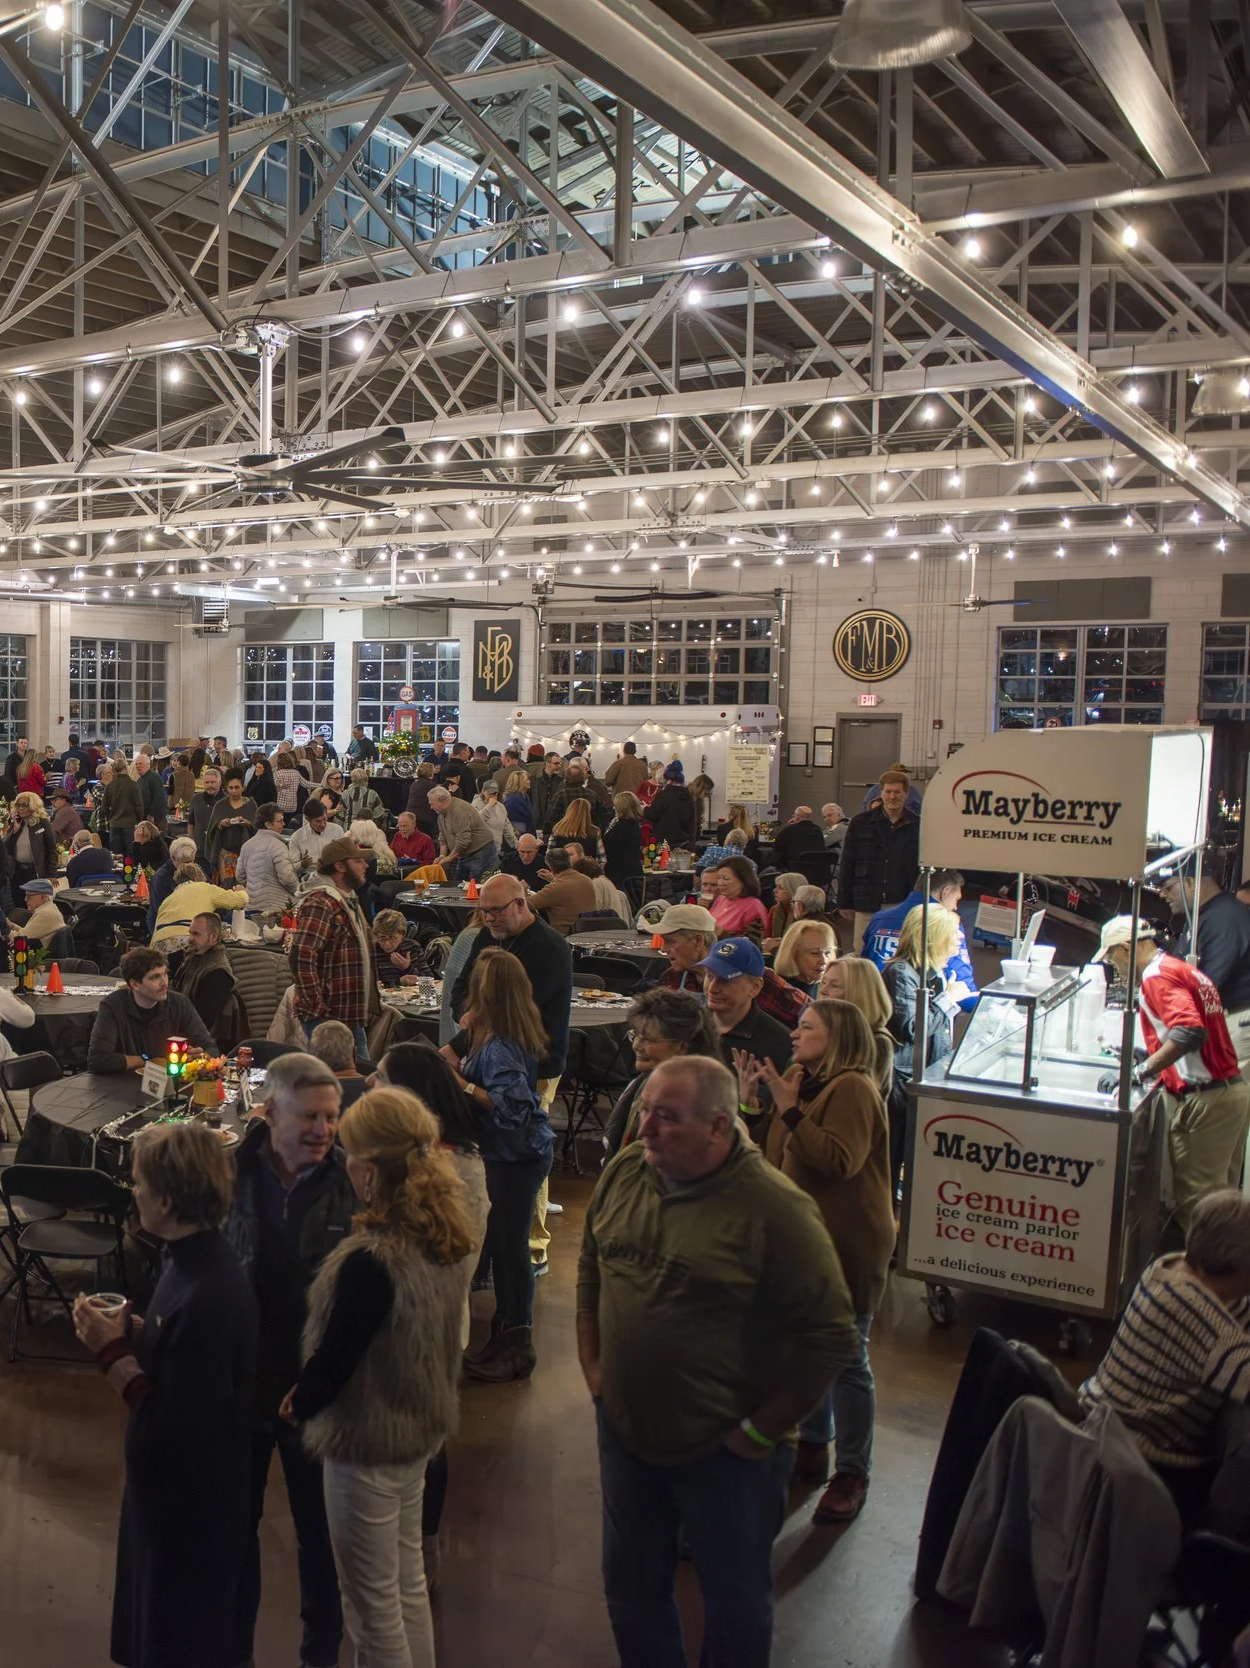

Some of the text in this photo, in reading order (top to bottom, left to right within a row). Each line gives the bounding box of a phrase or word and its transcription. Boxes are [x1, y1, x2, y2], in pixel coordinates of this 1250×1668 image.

[401, 690, 413, 698] GAS
[861, 695, 876, 706] EXIT
[961, 789, 1122, 830] Mayberry
[963, 828, 1113, 846] PREMIUM ICE CREAM
[933, 1130, 1095, 1188] Mayberry
[935, 1204, 1080, 1242] ice cream parlor
[937, 1180, 1081, 1227] Genuine
[935, 1217, 1076, 1263] ice cream
[940, 1255, 1007, 1280] delicious
[1010, 1270, 1095, 1297] experience
